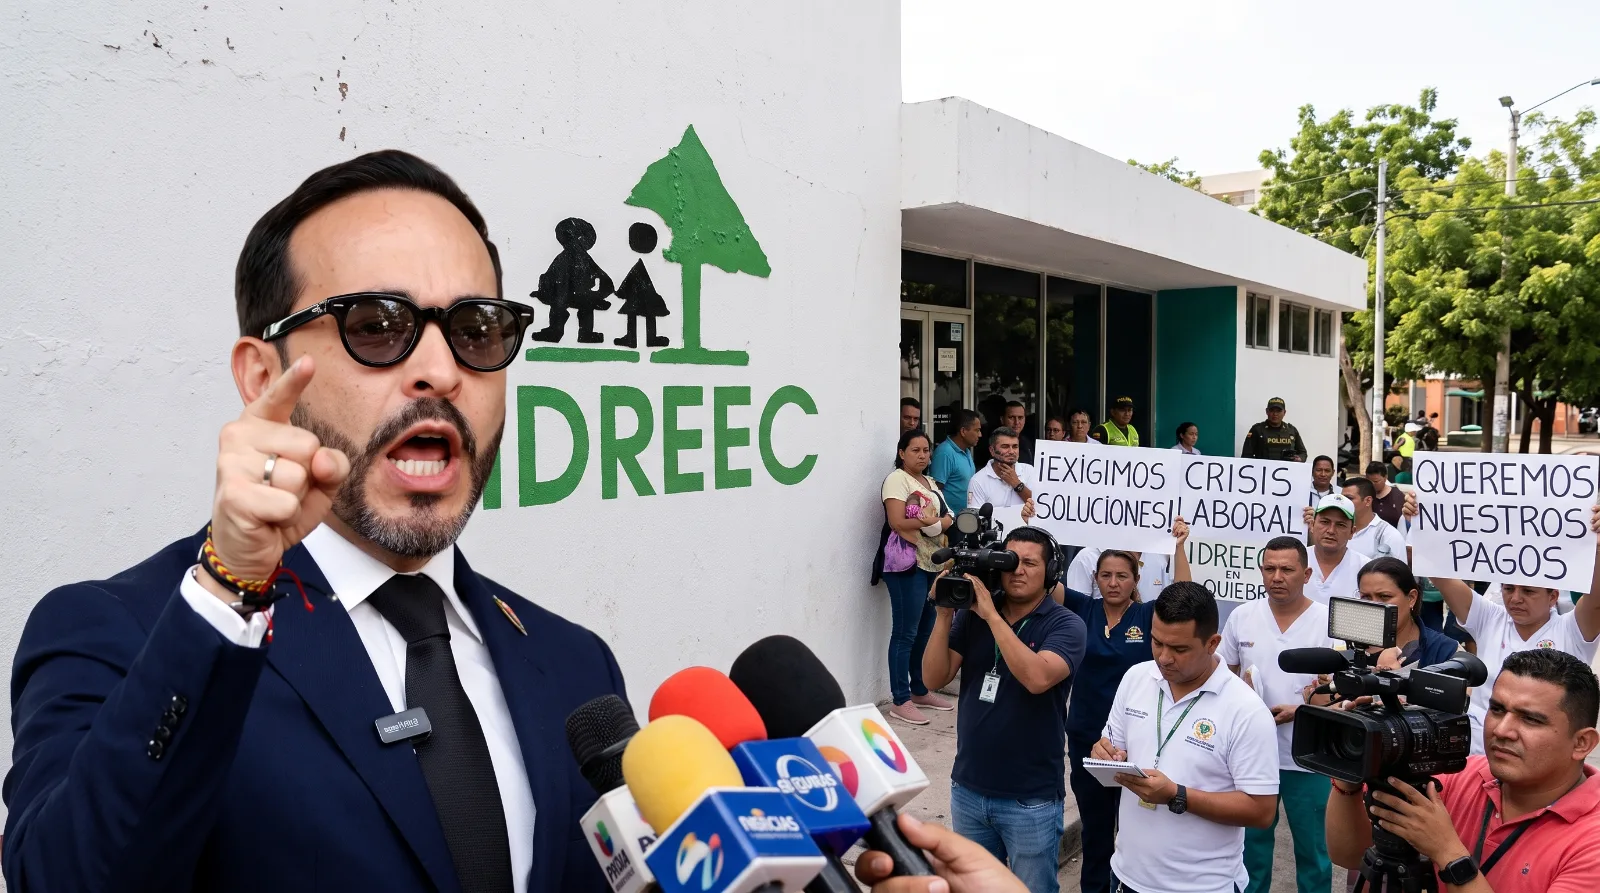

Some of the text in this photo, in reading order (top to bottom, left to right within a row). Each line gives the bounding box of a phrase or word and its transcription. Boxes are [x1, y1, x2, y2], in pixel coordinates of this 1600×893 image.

[1185, 460, 1292, 497] CRISIS
[1415, 459, 1595, 499] QUEREMOS
[1177, 496, 1303, 535] LABORAL
[1418, 502, 1588, 539] NUESTROS
[1225, 570, 1241, 580] EN
[1449, 539, 1568, 580] PAGOS
